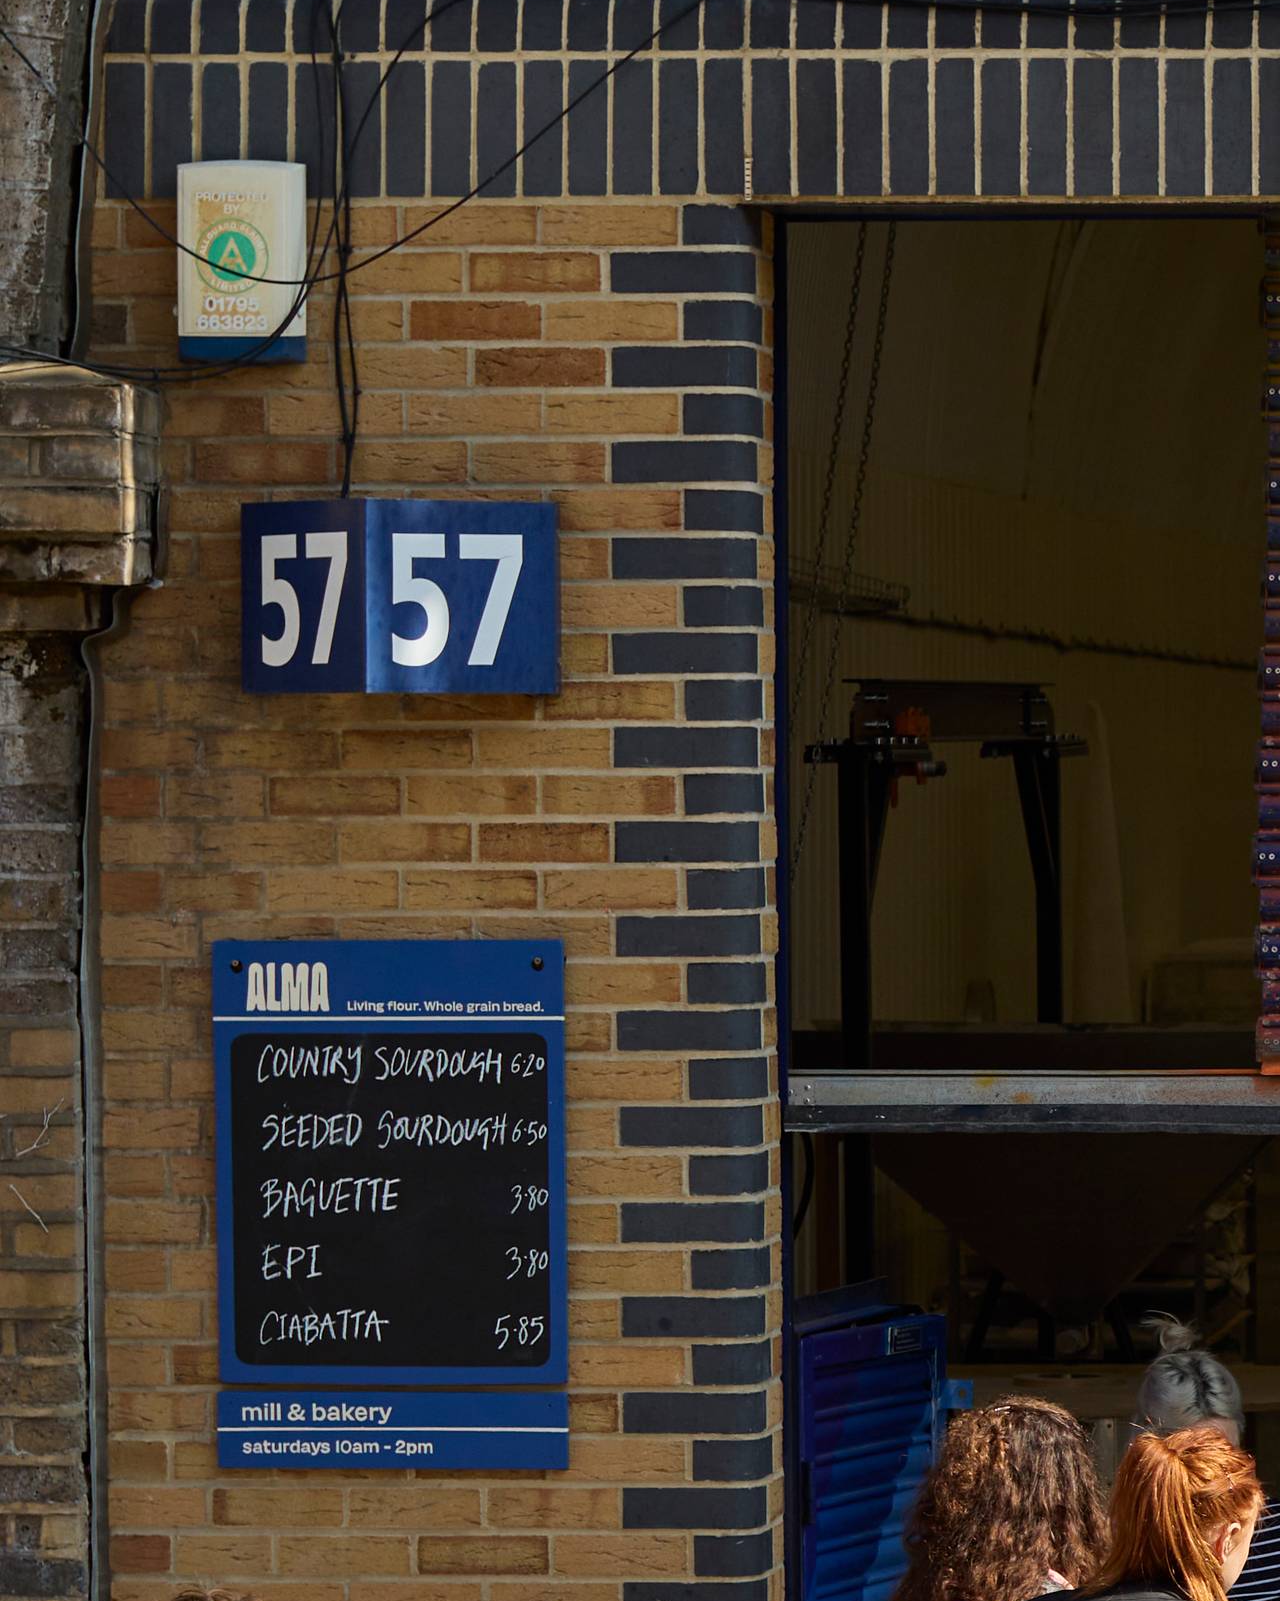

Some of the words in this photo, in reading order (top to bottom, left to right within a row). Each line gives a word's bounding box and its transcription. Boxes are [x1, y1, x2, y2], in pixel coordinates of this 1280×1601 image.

[223, 204, 241, 214] BY
[205, 297, 259, 312] 01795
[196, 315, 268, 332] 663823
[261, 531, 347, 667] 57
[392, 533, 523, 667] 57
[246, 962, 330, 1011] ALMA
[347, 1001, 384, 1013] Living
[388, 1001, 422, 1012] flour.
[424, 1001, 463, 1012] Whole
[467, 1002, 501, 1014] grain
[503, 1001, 545, 1013] bread.
[257, 1044, 362, 1084] COUNTRY
[375, 1045, 502, 1084] SOURDOUGH
[262, 1113, 363, 1151] SEEDED
[378, 1110, 508, 1151] SOURDOUGH
[260, 1177, 401, 1218] BAGUETTE
[261, 1244, 323, 1280] EPI
[259, 1309, 390, 1346] CIABATTA
[241, 1403, 282, 1422] mill
[287, 1403, 306, 1422] &
[312, 1403, 393, 1424] bakery
[242, 1440, 331, 1456] saturdays
[335, 1441, 380, 1454] 10am
[395, 1441, 434, 1456] 2pm
